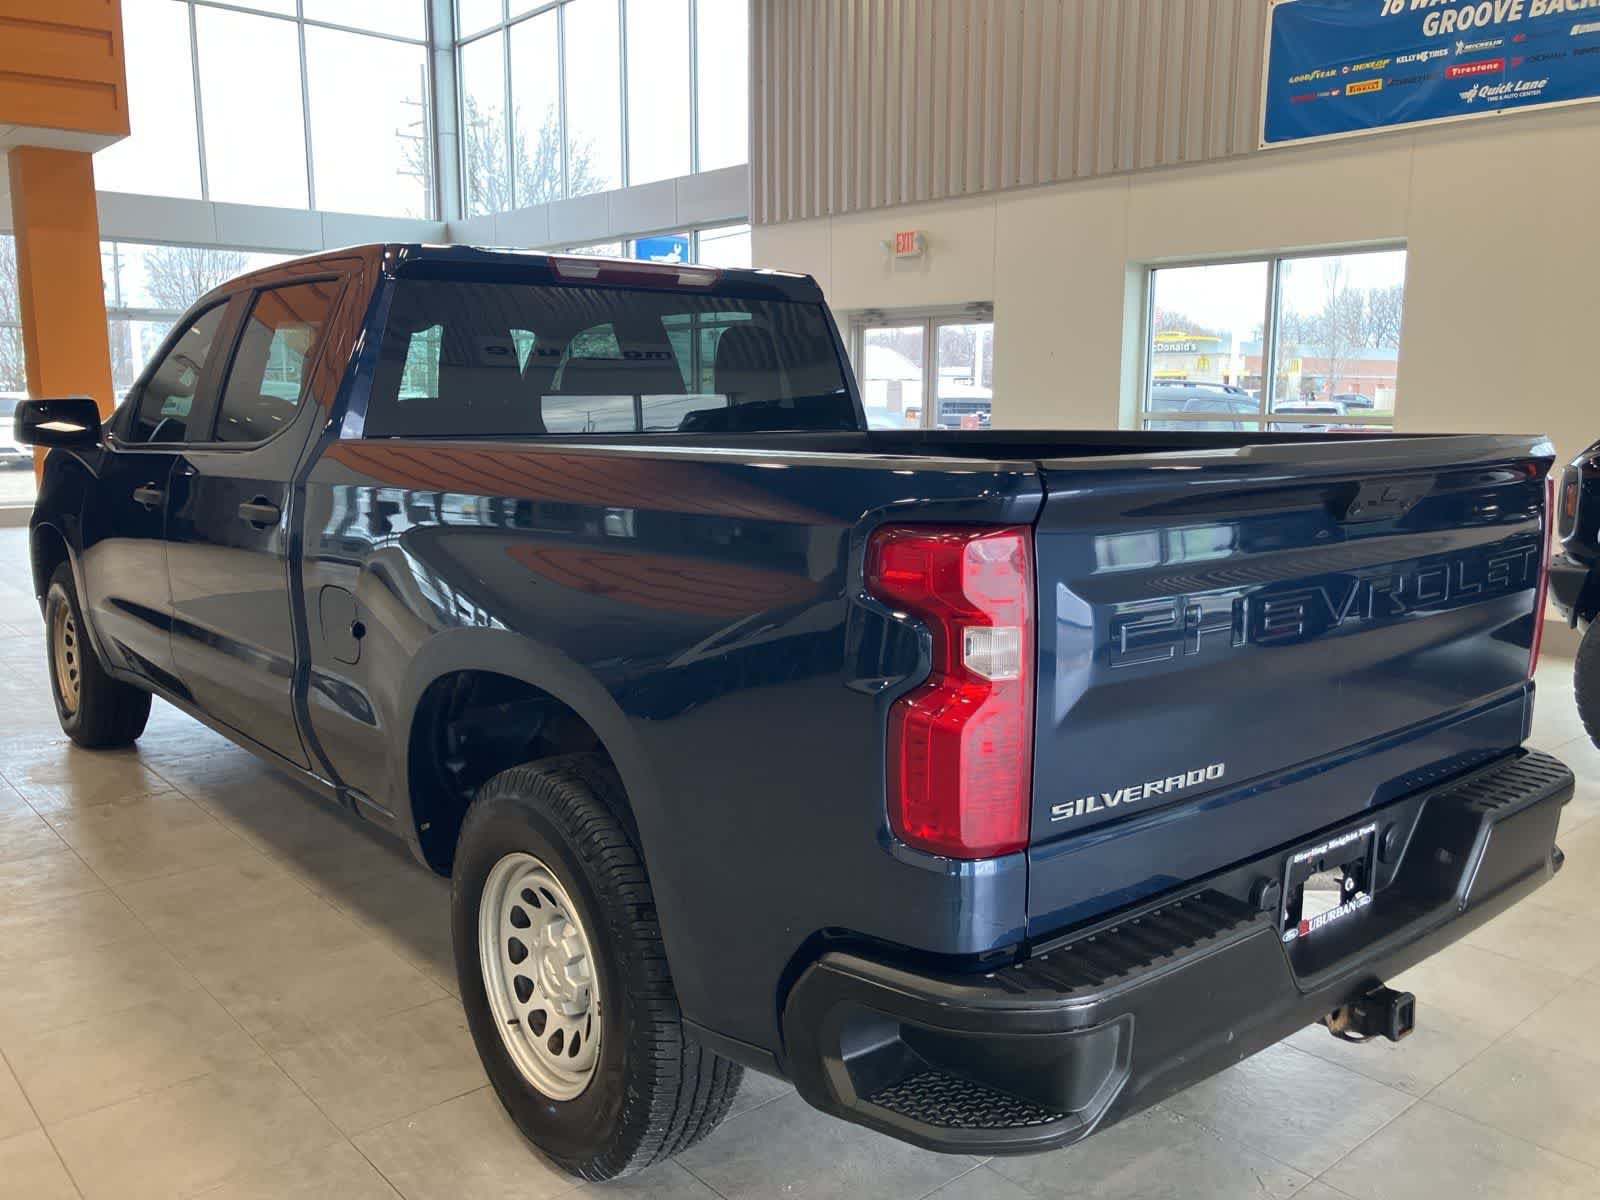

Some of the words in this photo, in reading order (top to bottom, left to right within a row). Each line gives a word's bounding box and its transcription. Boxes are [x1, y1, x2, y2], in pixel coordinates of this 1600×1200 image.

[1422, 0, 1524, 37] GROOVE
[1464, 40, 1503, 51] MICHELIN
[1396, 54, 1416, 65] KELLY
[1429, 48, 1449, 59] TIRES
[1451, 61, 1500, 77] Firestone
[1478, 81, 1514, 98] Quick
[1514, 79, 1549, 92] Lane
[1503, 92, 1519, 101] AUTO
[1519, 89, 1542, 98] CENTER
[896, 231, 914, 254] EXIT
[1152, 342, 1197, 352] cDonald's
[1109, 543, 1538, 669] CHEVROLET
[1050, 762, 1226, 823] SILVERADO
